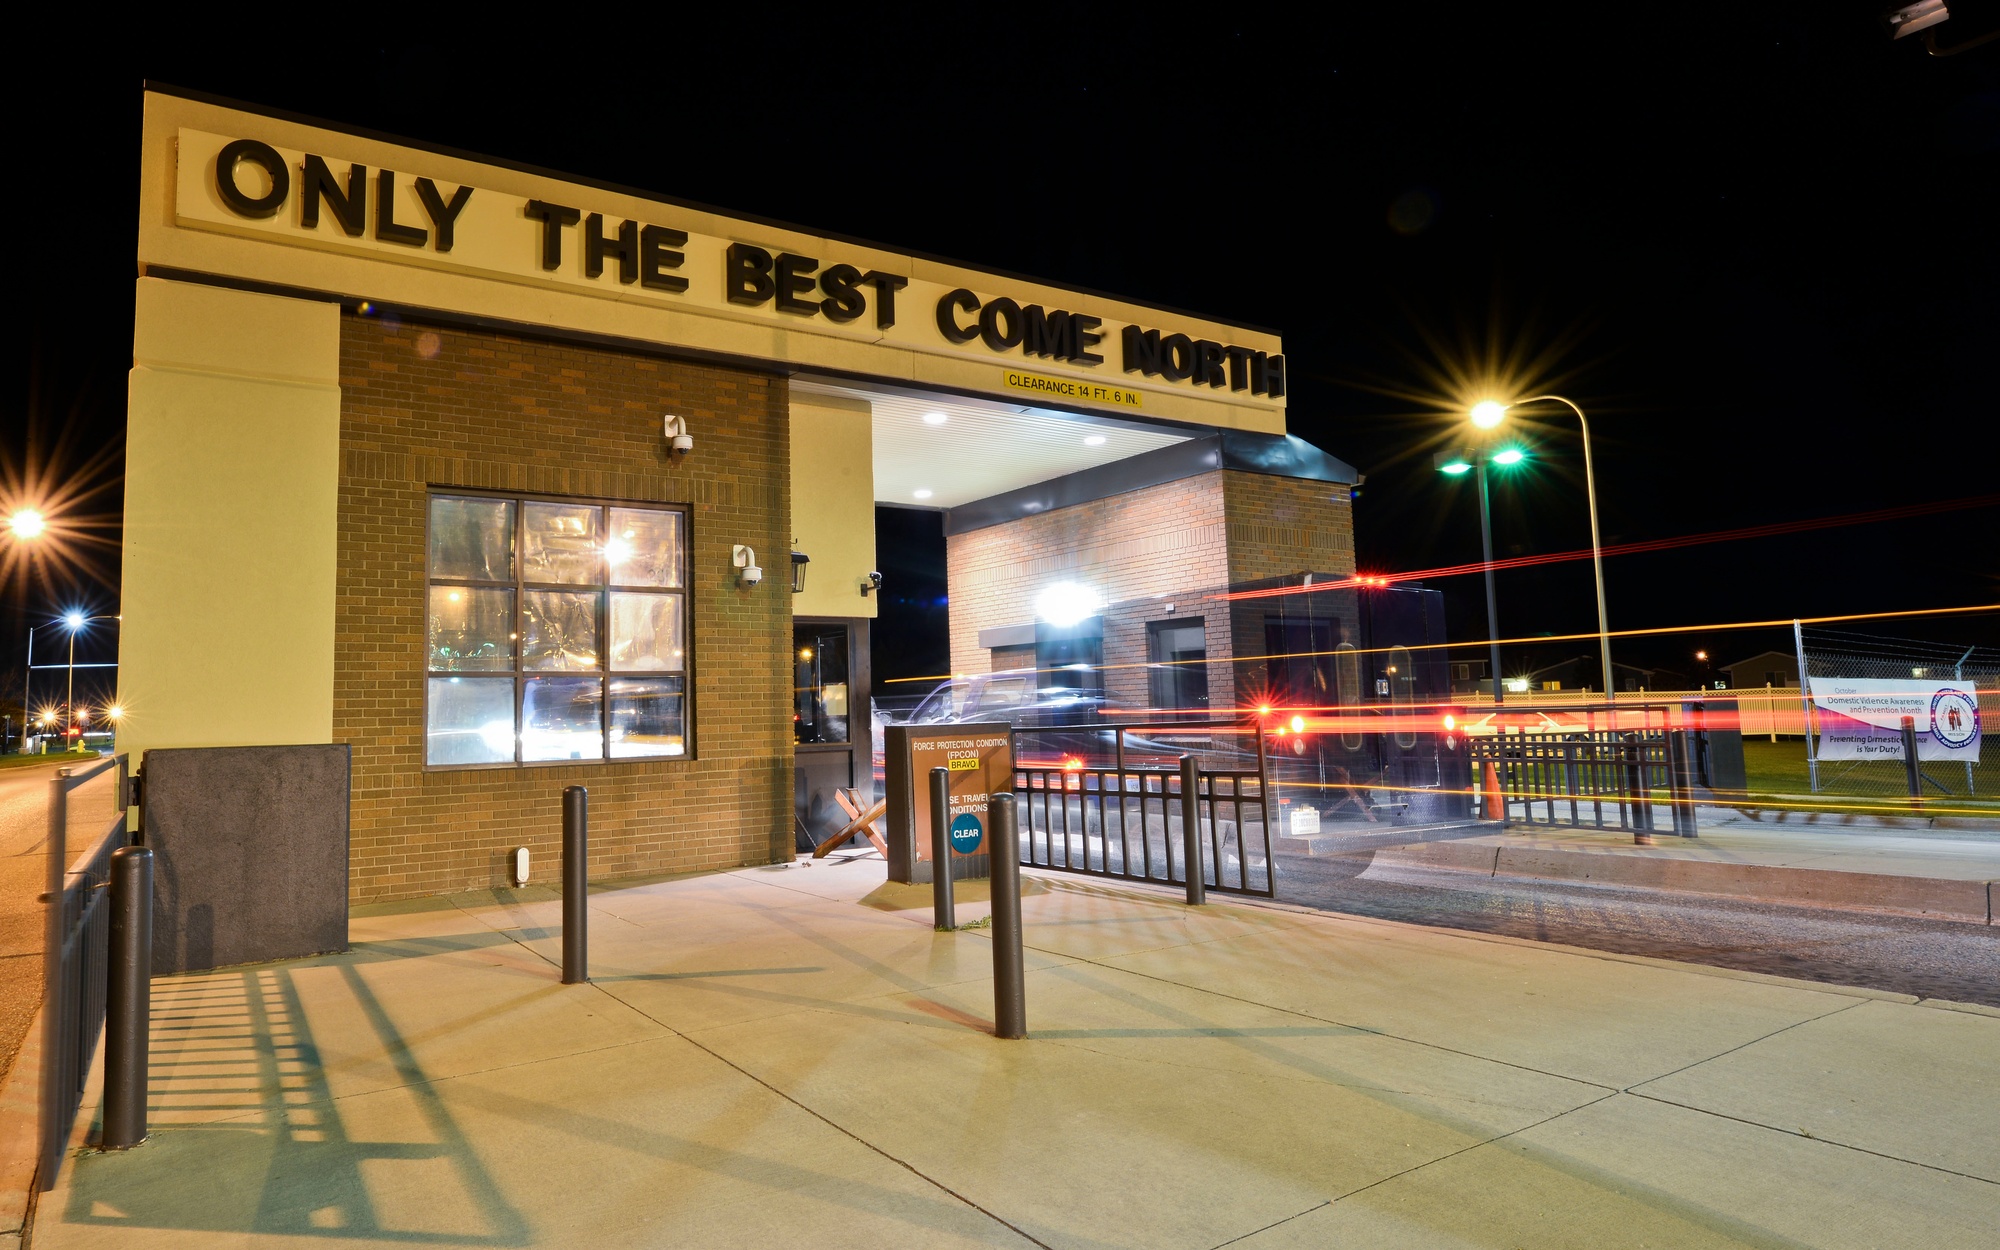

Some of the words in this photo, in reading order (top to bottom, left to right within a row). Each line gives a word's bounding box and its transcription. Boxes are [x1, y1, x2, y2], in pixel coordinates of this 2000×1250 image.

[215, 138, 475, 252] ONLY
[524, 198, 690, 293] THE
[726, 242, 908, 330] BEST
[936, 288, 1104, 367] COME
[1122, 325, 1286, 399] NORTH
[1009, 374, 1075, 395] CLEARANCE
[1078, 386, 1089, 397] 14
[1094, 388, 1110, 401] FT.
[1114, 391, 1121, 402] 6
[1126, 393, 1138, 405] IN.
[1827, 696, 1860, 705] Domestic
[1890, 697, 1925, 706] Awareness
[1863, 706, 1899, 714] Prevention
[913, 741, 935, 751] FORCE
[937, 740, 974, 750] PROTECTION
[976, 738, 1008, 748] CONDITION
[1856, 745, 1863, 753] is
[1879, 745, 1900, 754] Duty!
[947, 749, 979, 760] (FPCON)
[951, 760, 976, 769] BRAVO
[962, 793, 989, 803] TRAVEL
[949, 803, 988, 815] ONDITIONS
[953, 828, 979, 839] CLEAR
